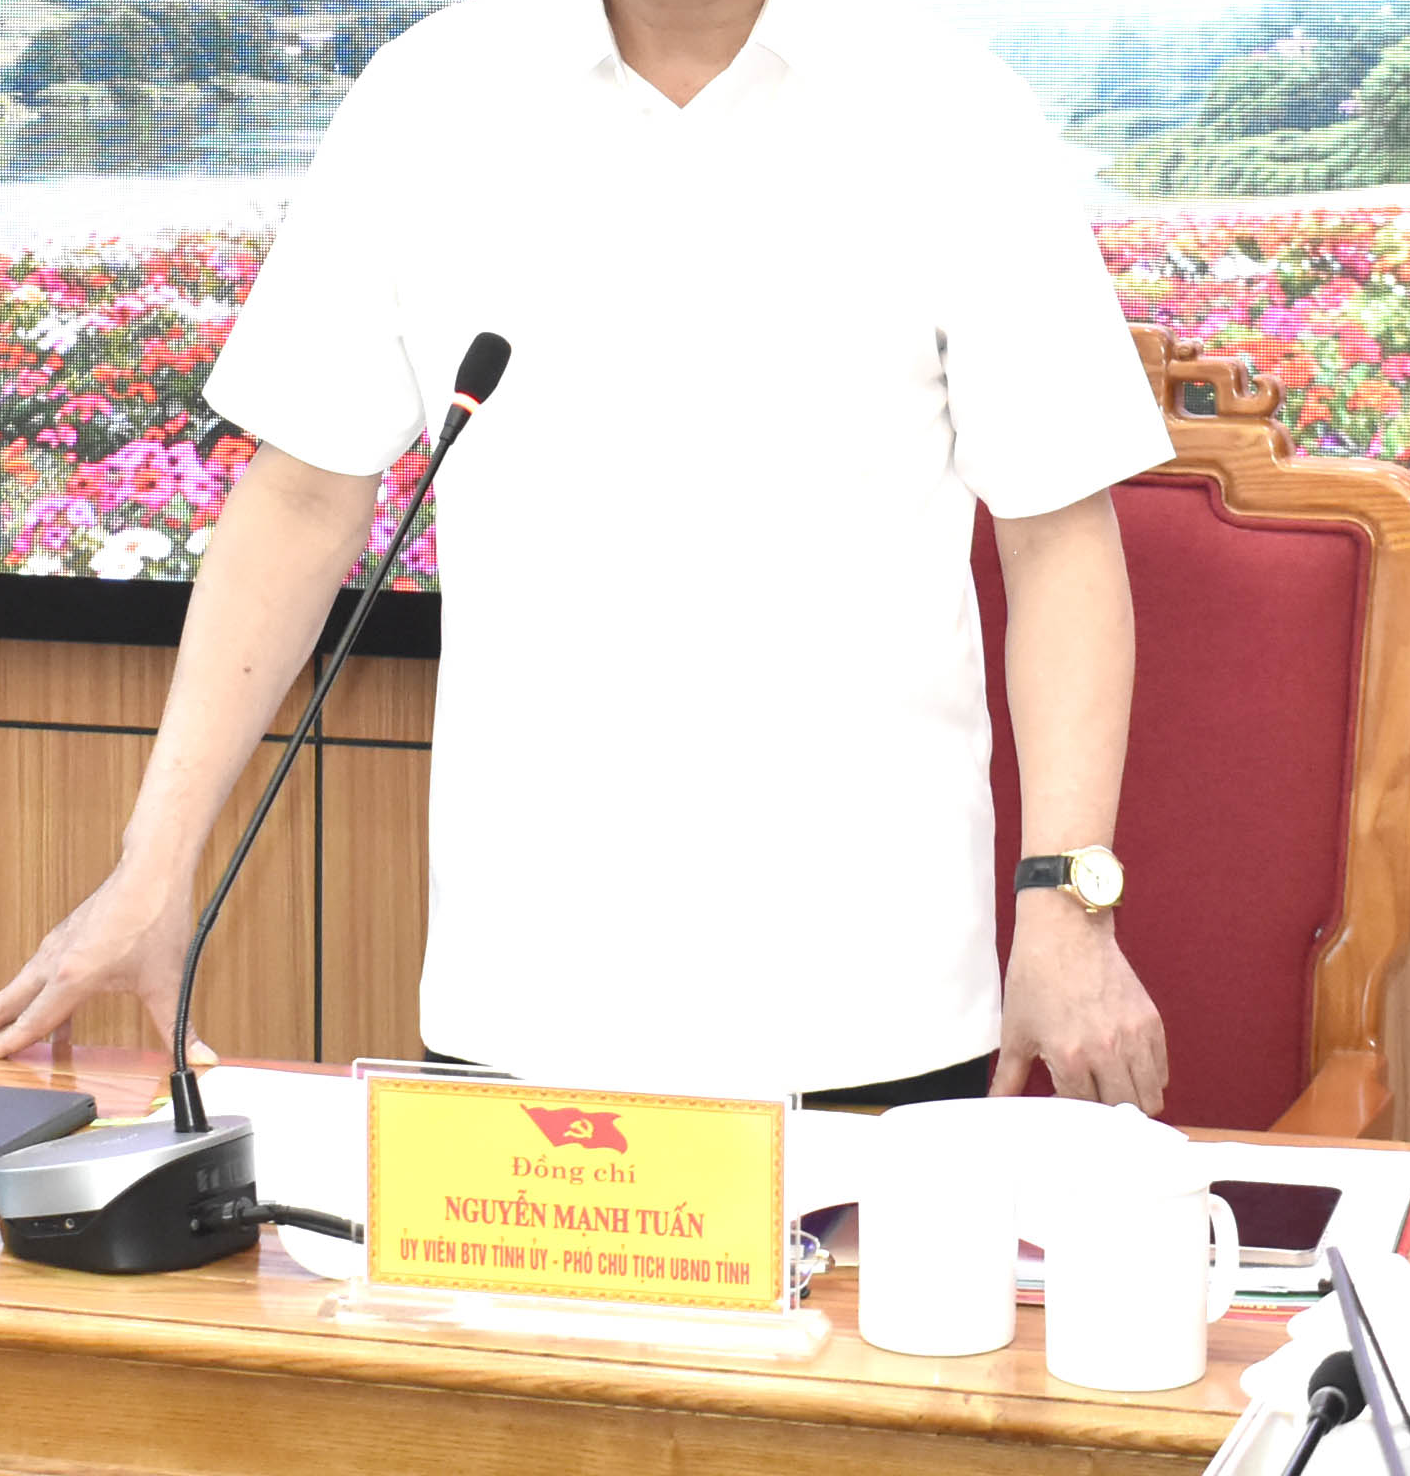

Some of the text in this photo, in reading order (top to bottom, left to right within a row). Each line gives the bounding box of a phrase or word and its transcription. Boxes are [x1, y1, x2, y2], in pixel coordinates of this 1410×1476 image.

[512, 1154, 636, 1185] Đồng chí
[444, 1189, 705, 1239] NGUYỄN MẠNH TUẤN
[423, 1235, 456, 1264] VIÊN
[461, 1242, 487, 1266] BTV
[563, 1246, 593, 1274] PHÓ
[598, 1243, 628, 1276] CHỦ
[633, 1254, 665, 1283] TỊCH
[670, 1257, 711, 1282] UBND
